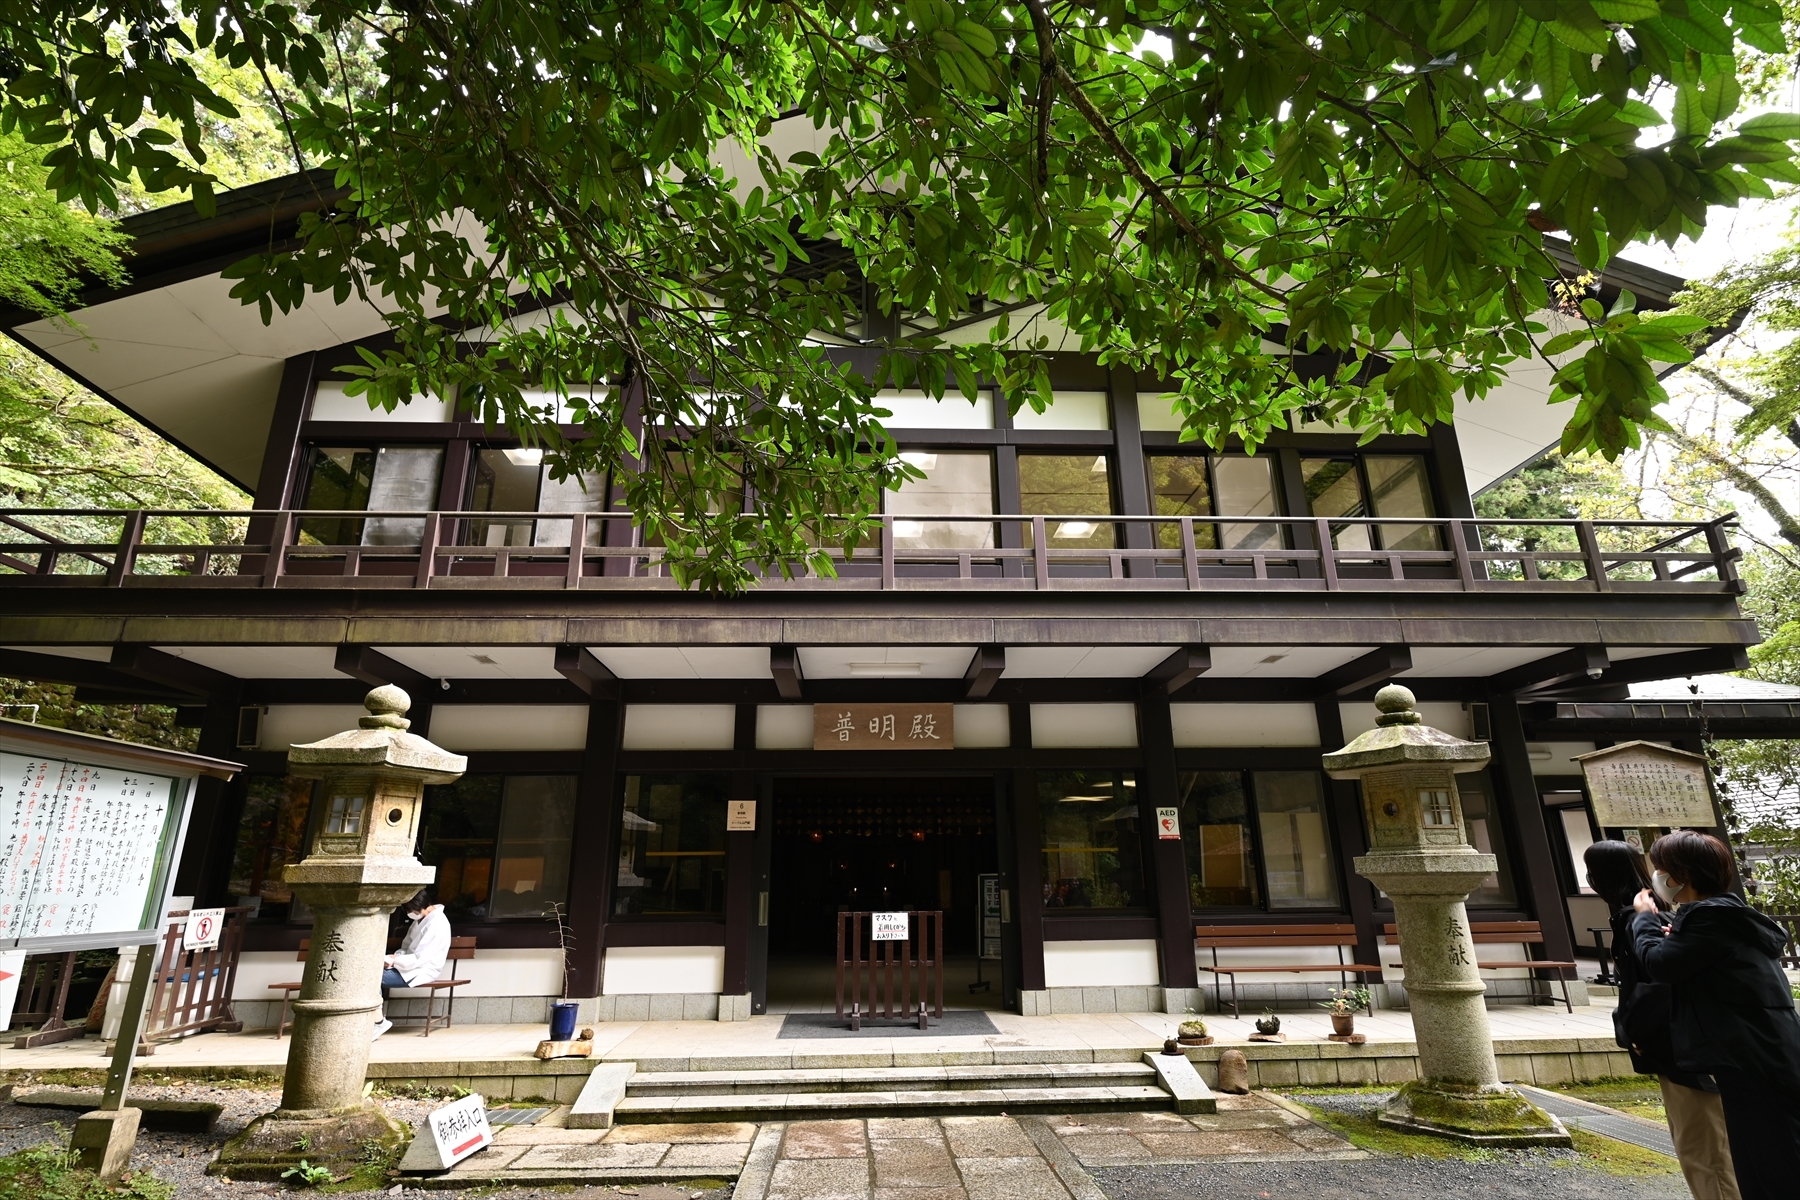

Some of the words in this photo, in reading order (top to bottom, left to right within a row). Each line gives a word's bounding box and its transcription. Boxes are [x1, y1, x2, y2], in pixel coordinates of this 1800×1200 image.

[831, 712, 940, 742] 普明殿
[22, 763, 35, 787] 二十八日
[35, 763, 47, 788] 二十四日
[66, 767, 78, 791] 十八日
[77, 767, 89, 792] 十四日
[89, 770, 100, 790] 九日
[120, 776, 130, 795] 七日
[129, 778, 137, 796] 三日
[145, 782, 154, 797] 一日
[12, 790, 25, 829] 午前十時
[23, 791, 37, 830] 午前十一時
[35, 793, 49, 829] 午後一時
[99, 800, 113, 833] 午後一時
[137, 804, 162, 886] 十月の行事
[1444, 917, 1469, 965] 奉献
[316, 930, 344, 983] 奉献
[438, 1108, 482, 1145] 御参拝入口
